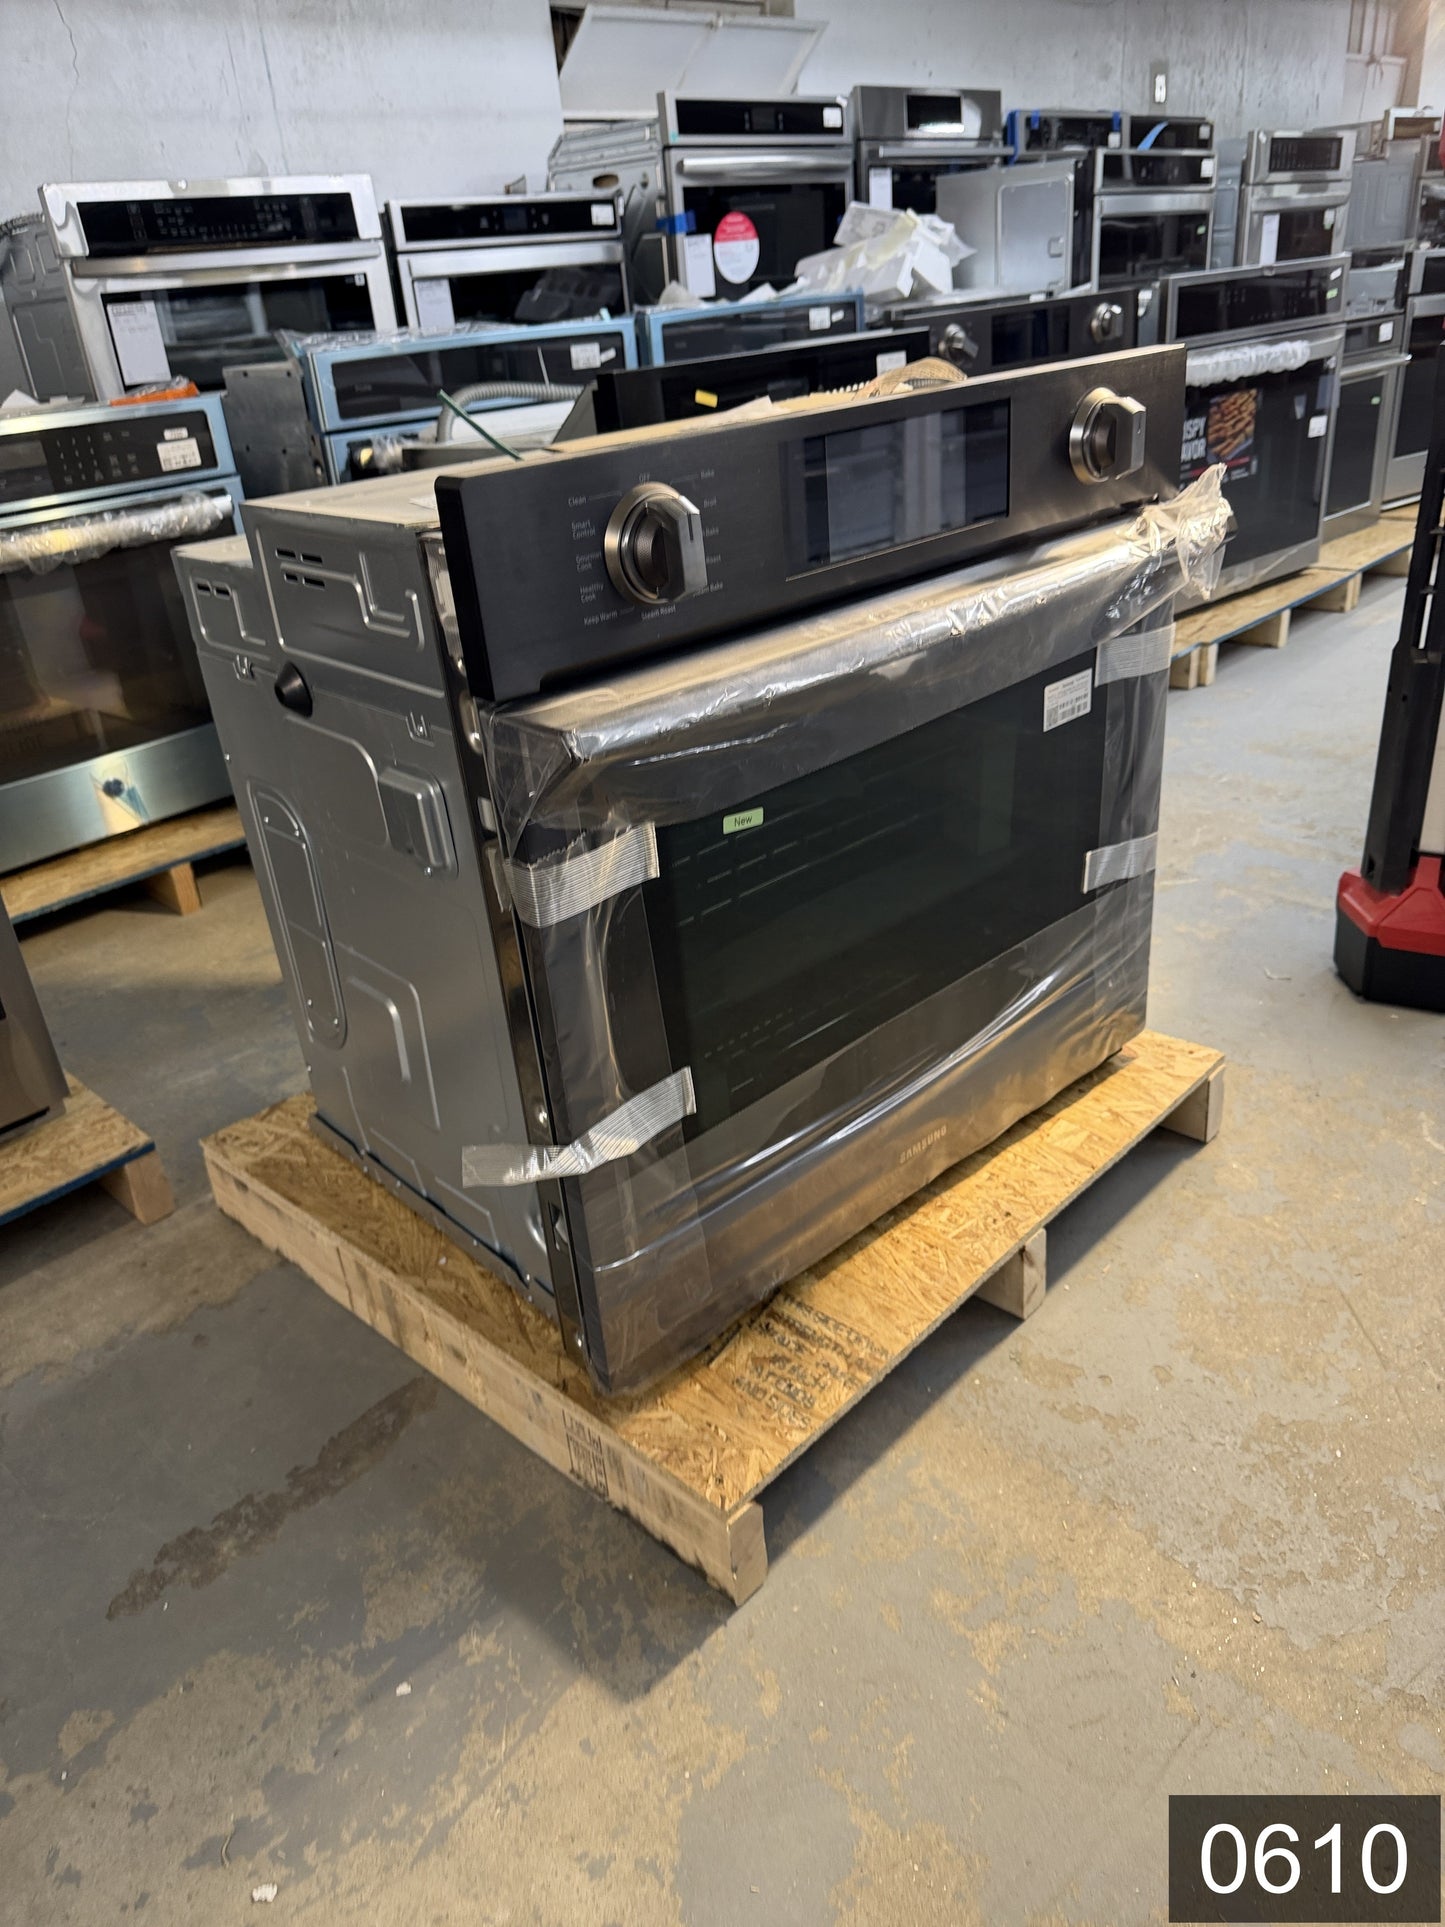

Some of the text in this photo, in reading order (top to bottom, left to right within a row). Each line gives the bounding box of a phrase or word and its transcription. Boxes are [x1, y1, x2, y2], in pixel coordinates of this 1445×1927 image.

[568, 495, 587, 507] Clean
[571, 519, 591, 531] Smart
[572, 526, 596, 540] Control
[580, 582, 604, 595] Healthy
[581, 593, 596, 604] Cook
[584, 609, 618, 626] Keep Warm
[734, 815, 753, 827] New
[899, 1124, 947, 1164] SAMSUNG
